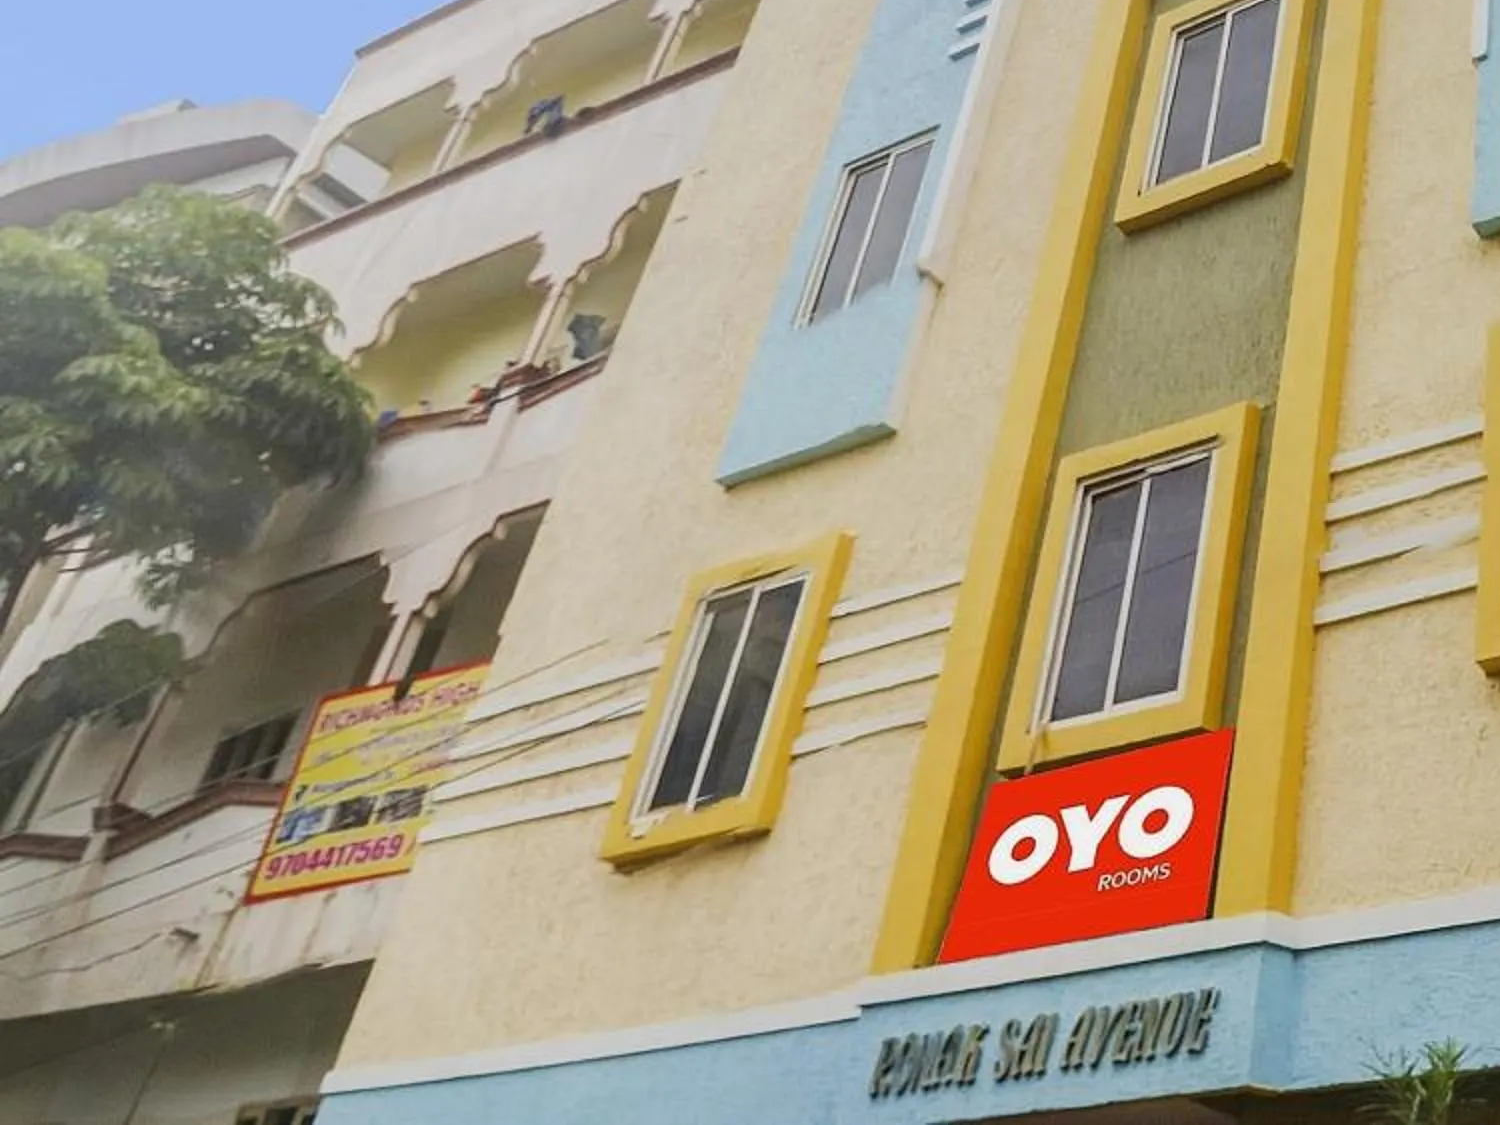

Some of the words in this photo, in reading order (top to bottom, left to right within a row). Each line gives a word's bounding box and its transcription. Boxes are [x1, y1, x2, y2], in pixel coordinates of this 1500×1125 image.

[264, 833, 405, 880] 9704417569
[988, 785, 1195, 886] OYO
[1097, 863, 1172, 892] ROOMS
[993, 1011, 1061, 1083] SAI
[1060, 986, 1222, 1072] AVENUE
